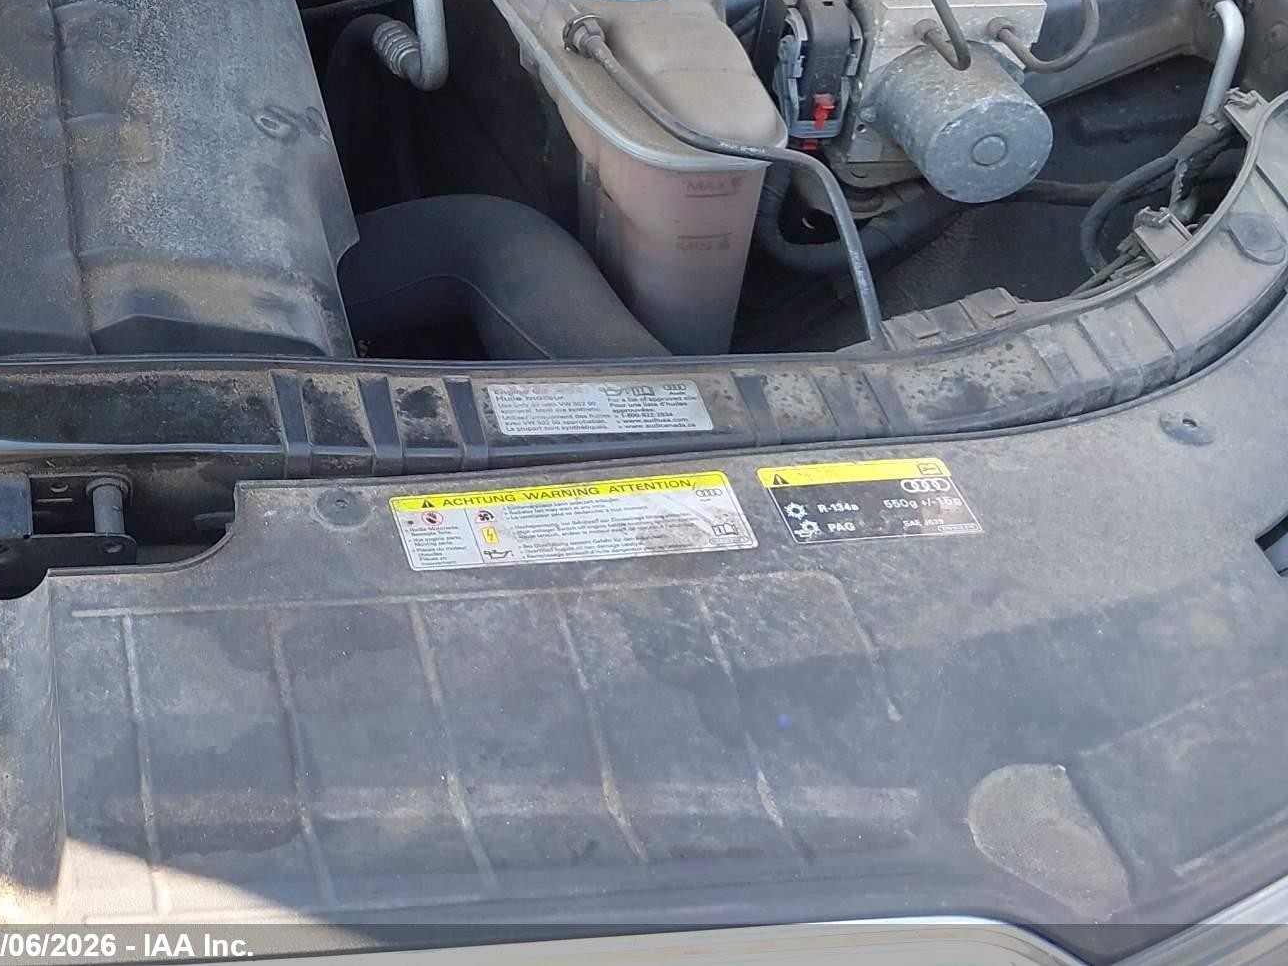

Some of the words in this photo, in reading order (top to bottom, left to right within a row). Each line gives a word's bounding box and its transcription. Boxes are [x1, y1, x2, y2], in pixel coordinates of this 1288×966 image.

[442, 493, 516, 507] ACHTUNG
[523, 487, 601, 500] WARNING
[608, 479, 692, 493] ATTENTION
[816, 502, 860, 513] R-134a
[827, 521, 856, 532] PAG
